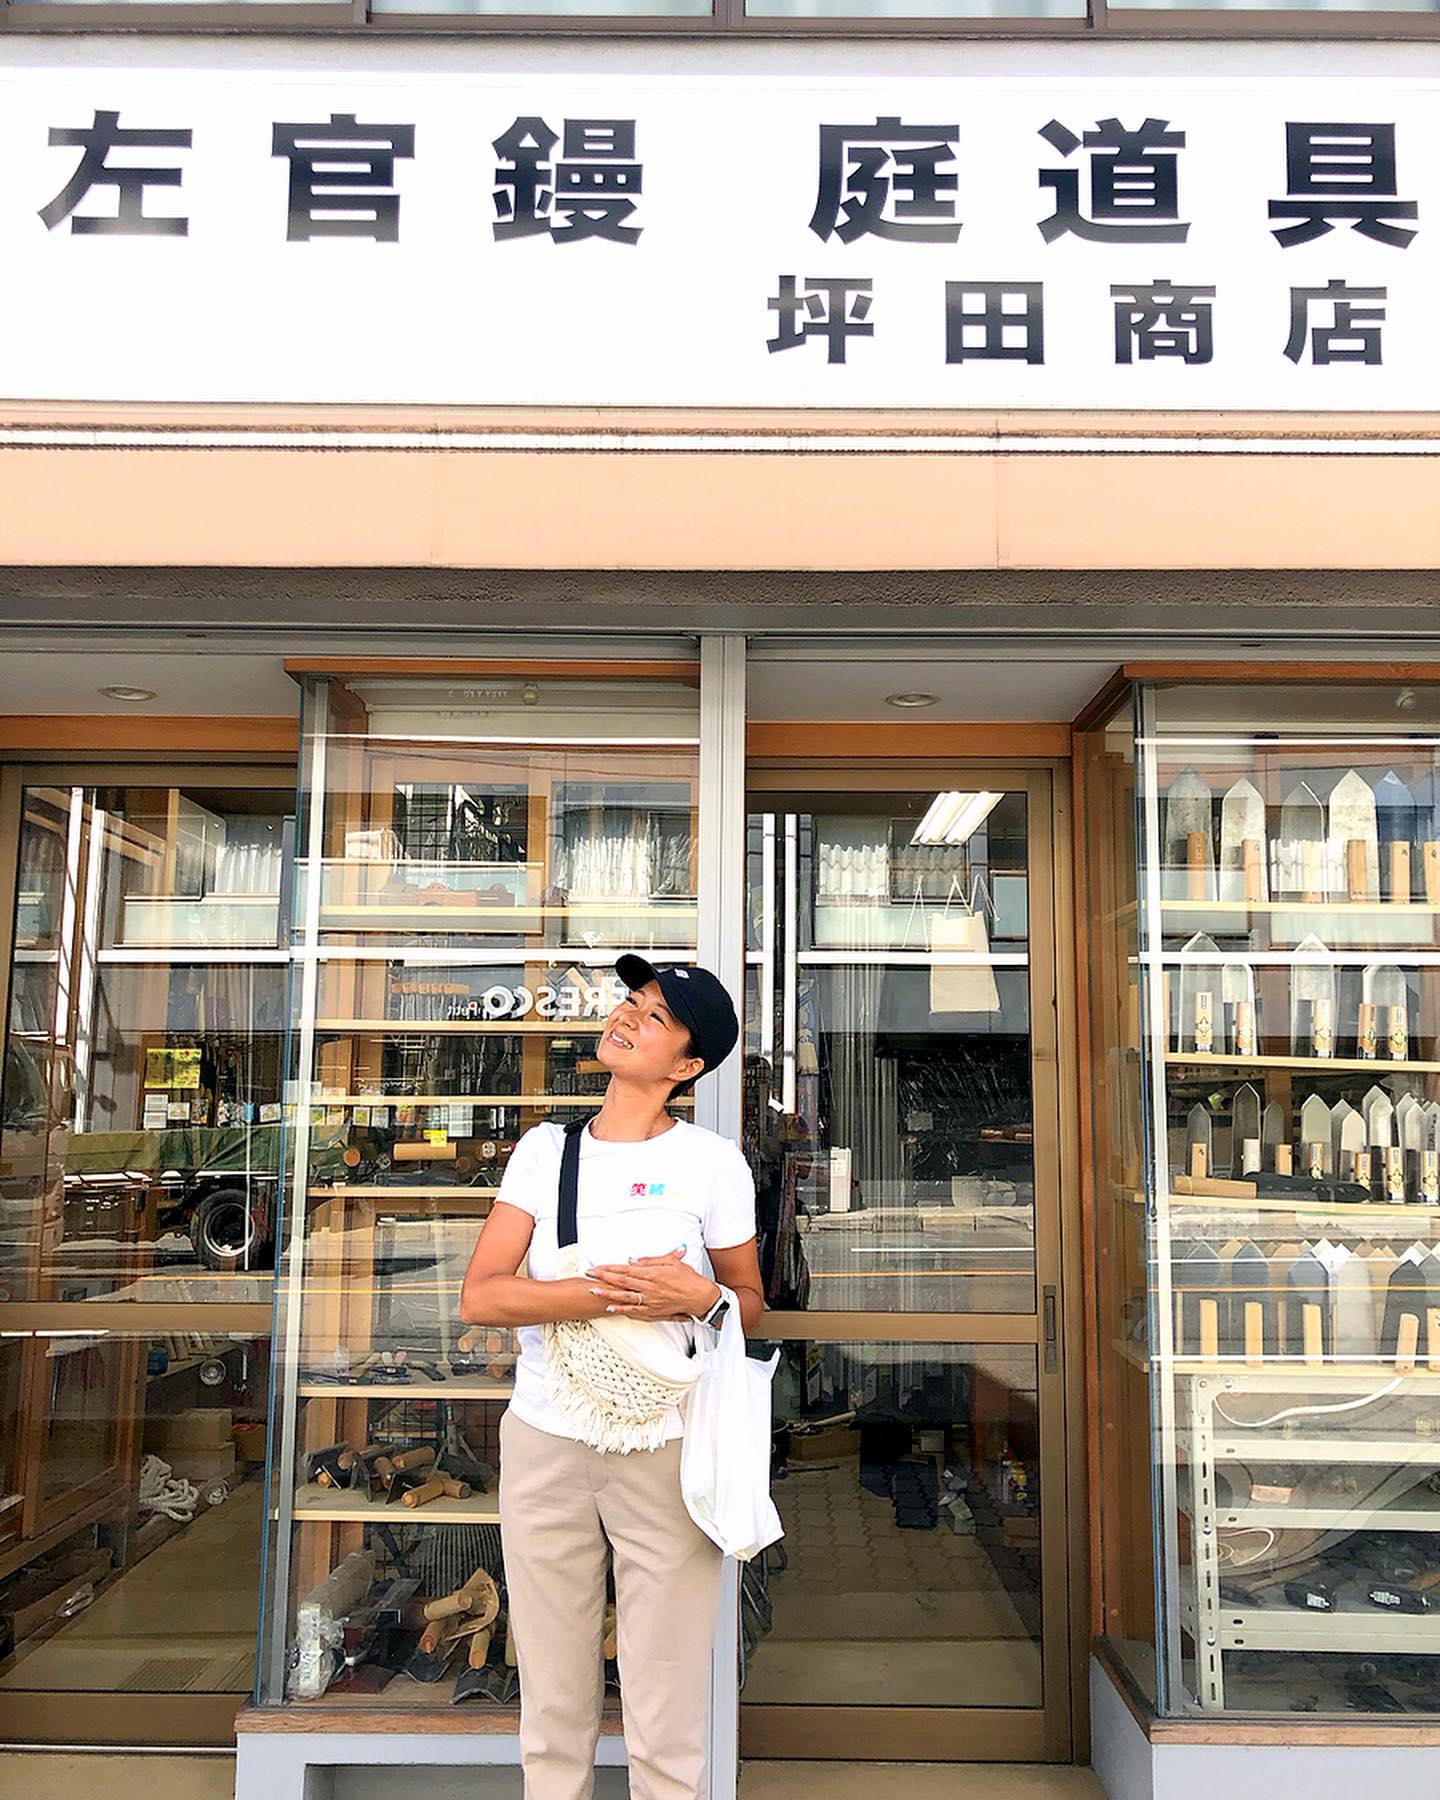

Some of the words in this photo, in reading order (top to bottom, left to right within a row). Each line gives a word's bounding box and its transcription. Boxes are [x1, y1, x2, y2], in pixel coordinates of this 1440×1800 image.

[38, 109, 644, 246] 左官鏝
[808, 116, 1419, 250] 庭道具
[765, 274, 1388, 366] 坪田商店
